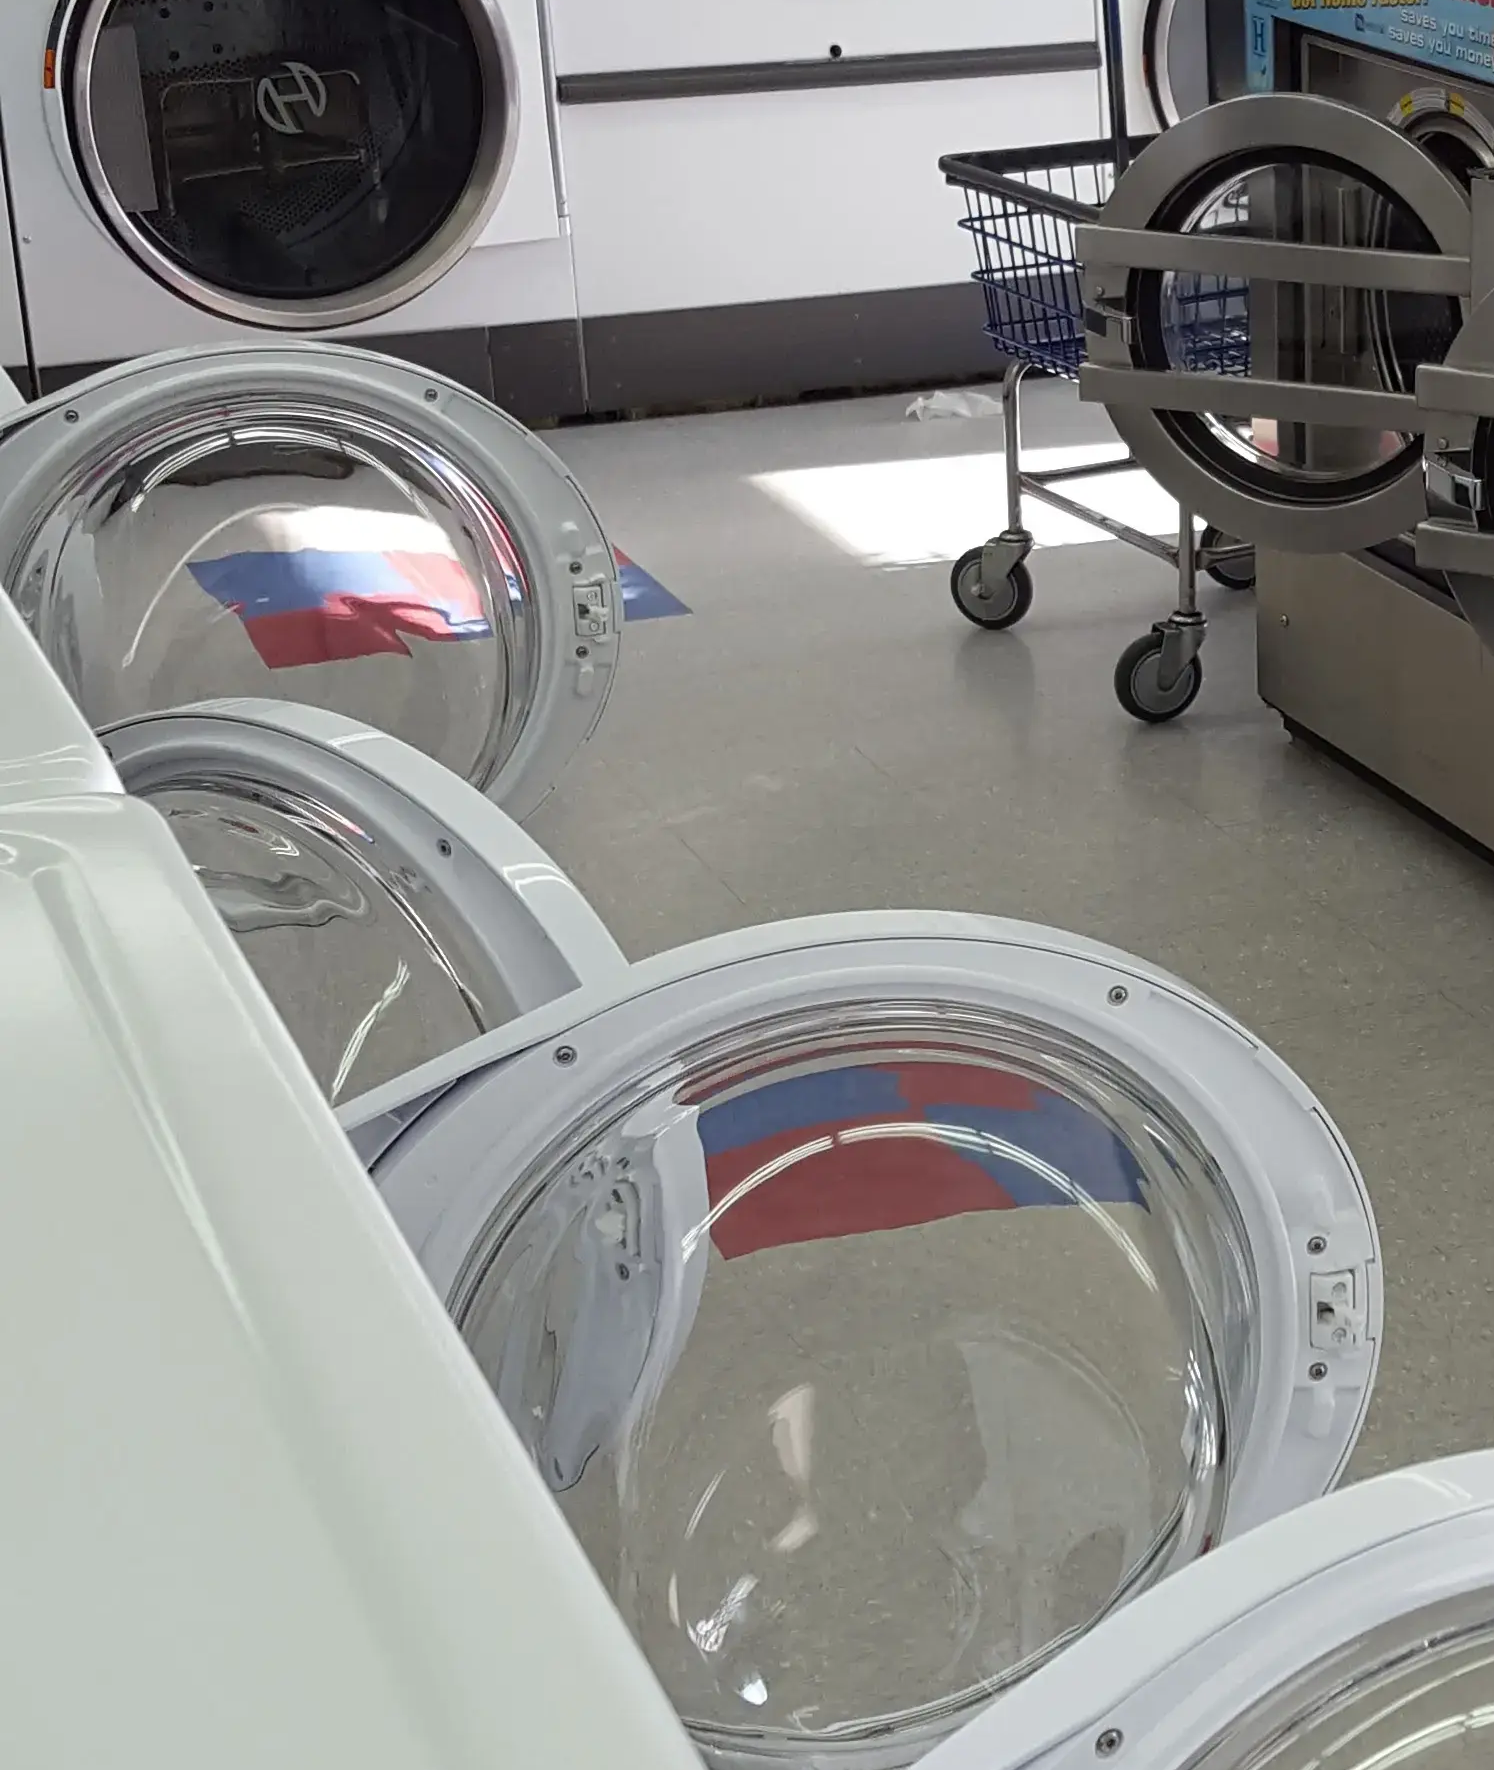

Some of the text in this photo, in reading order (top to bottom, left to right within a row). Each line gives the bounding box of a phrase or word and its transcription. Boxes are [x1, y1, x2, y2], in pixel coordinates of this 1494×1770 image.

[1400, 8, 1437, 30] saves
[1442, 21, 1464, 39] you
[1388, 27, 1425, 48] saves
[1428, 37, 1451, 58] you
